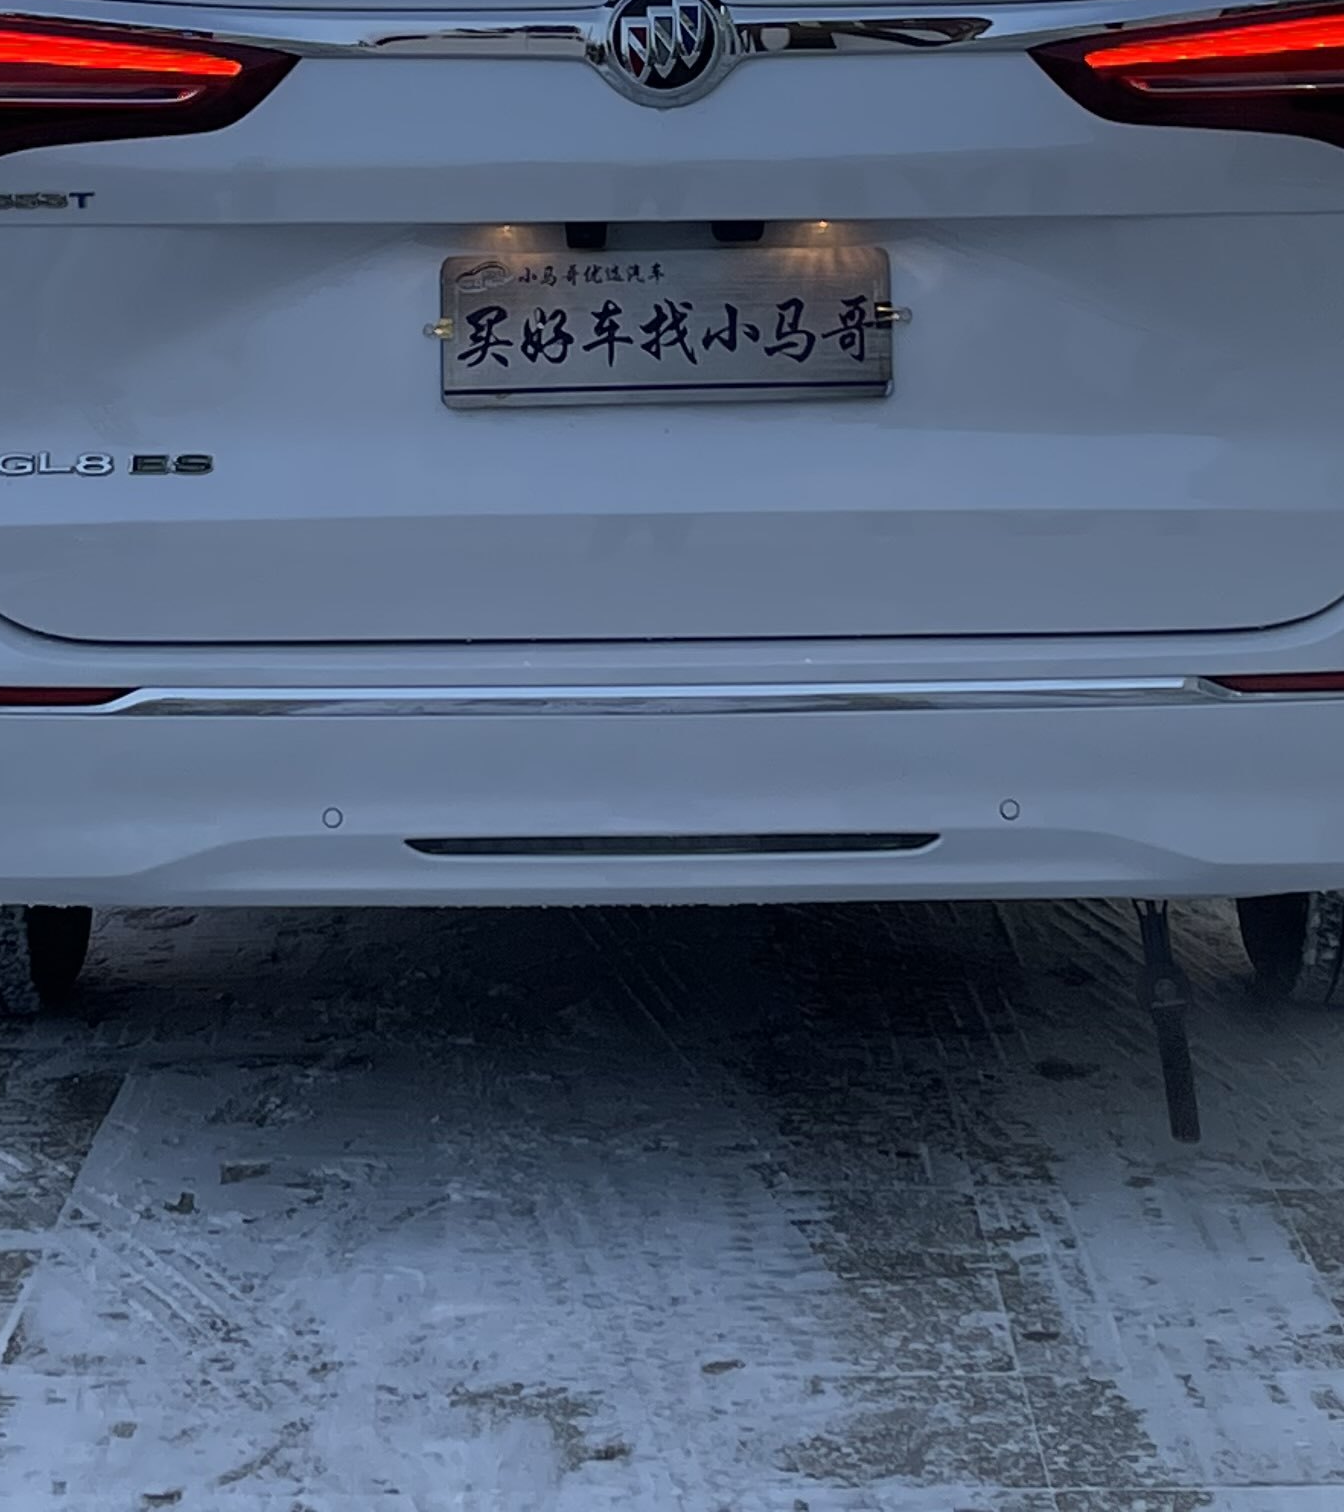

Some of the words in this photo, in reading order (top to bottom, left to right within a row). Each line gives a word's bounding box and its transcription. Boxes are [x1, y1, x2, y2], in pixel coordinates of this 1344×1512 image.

[457, 296, 877, 367] 买好车找小马哥
[128, 453, 214, 475] ES
